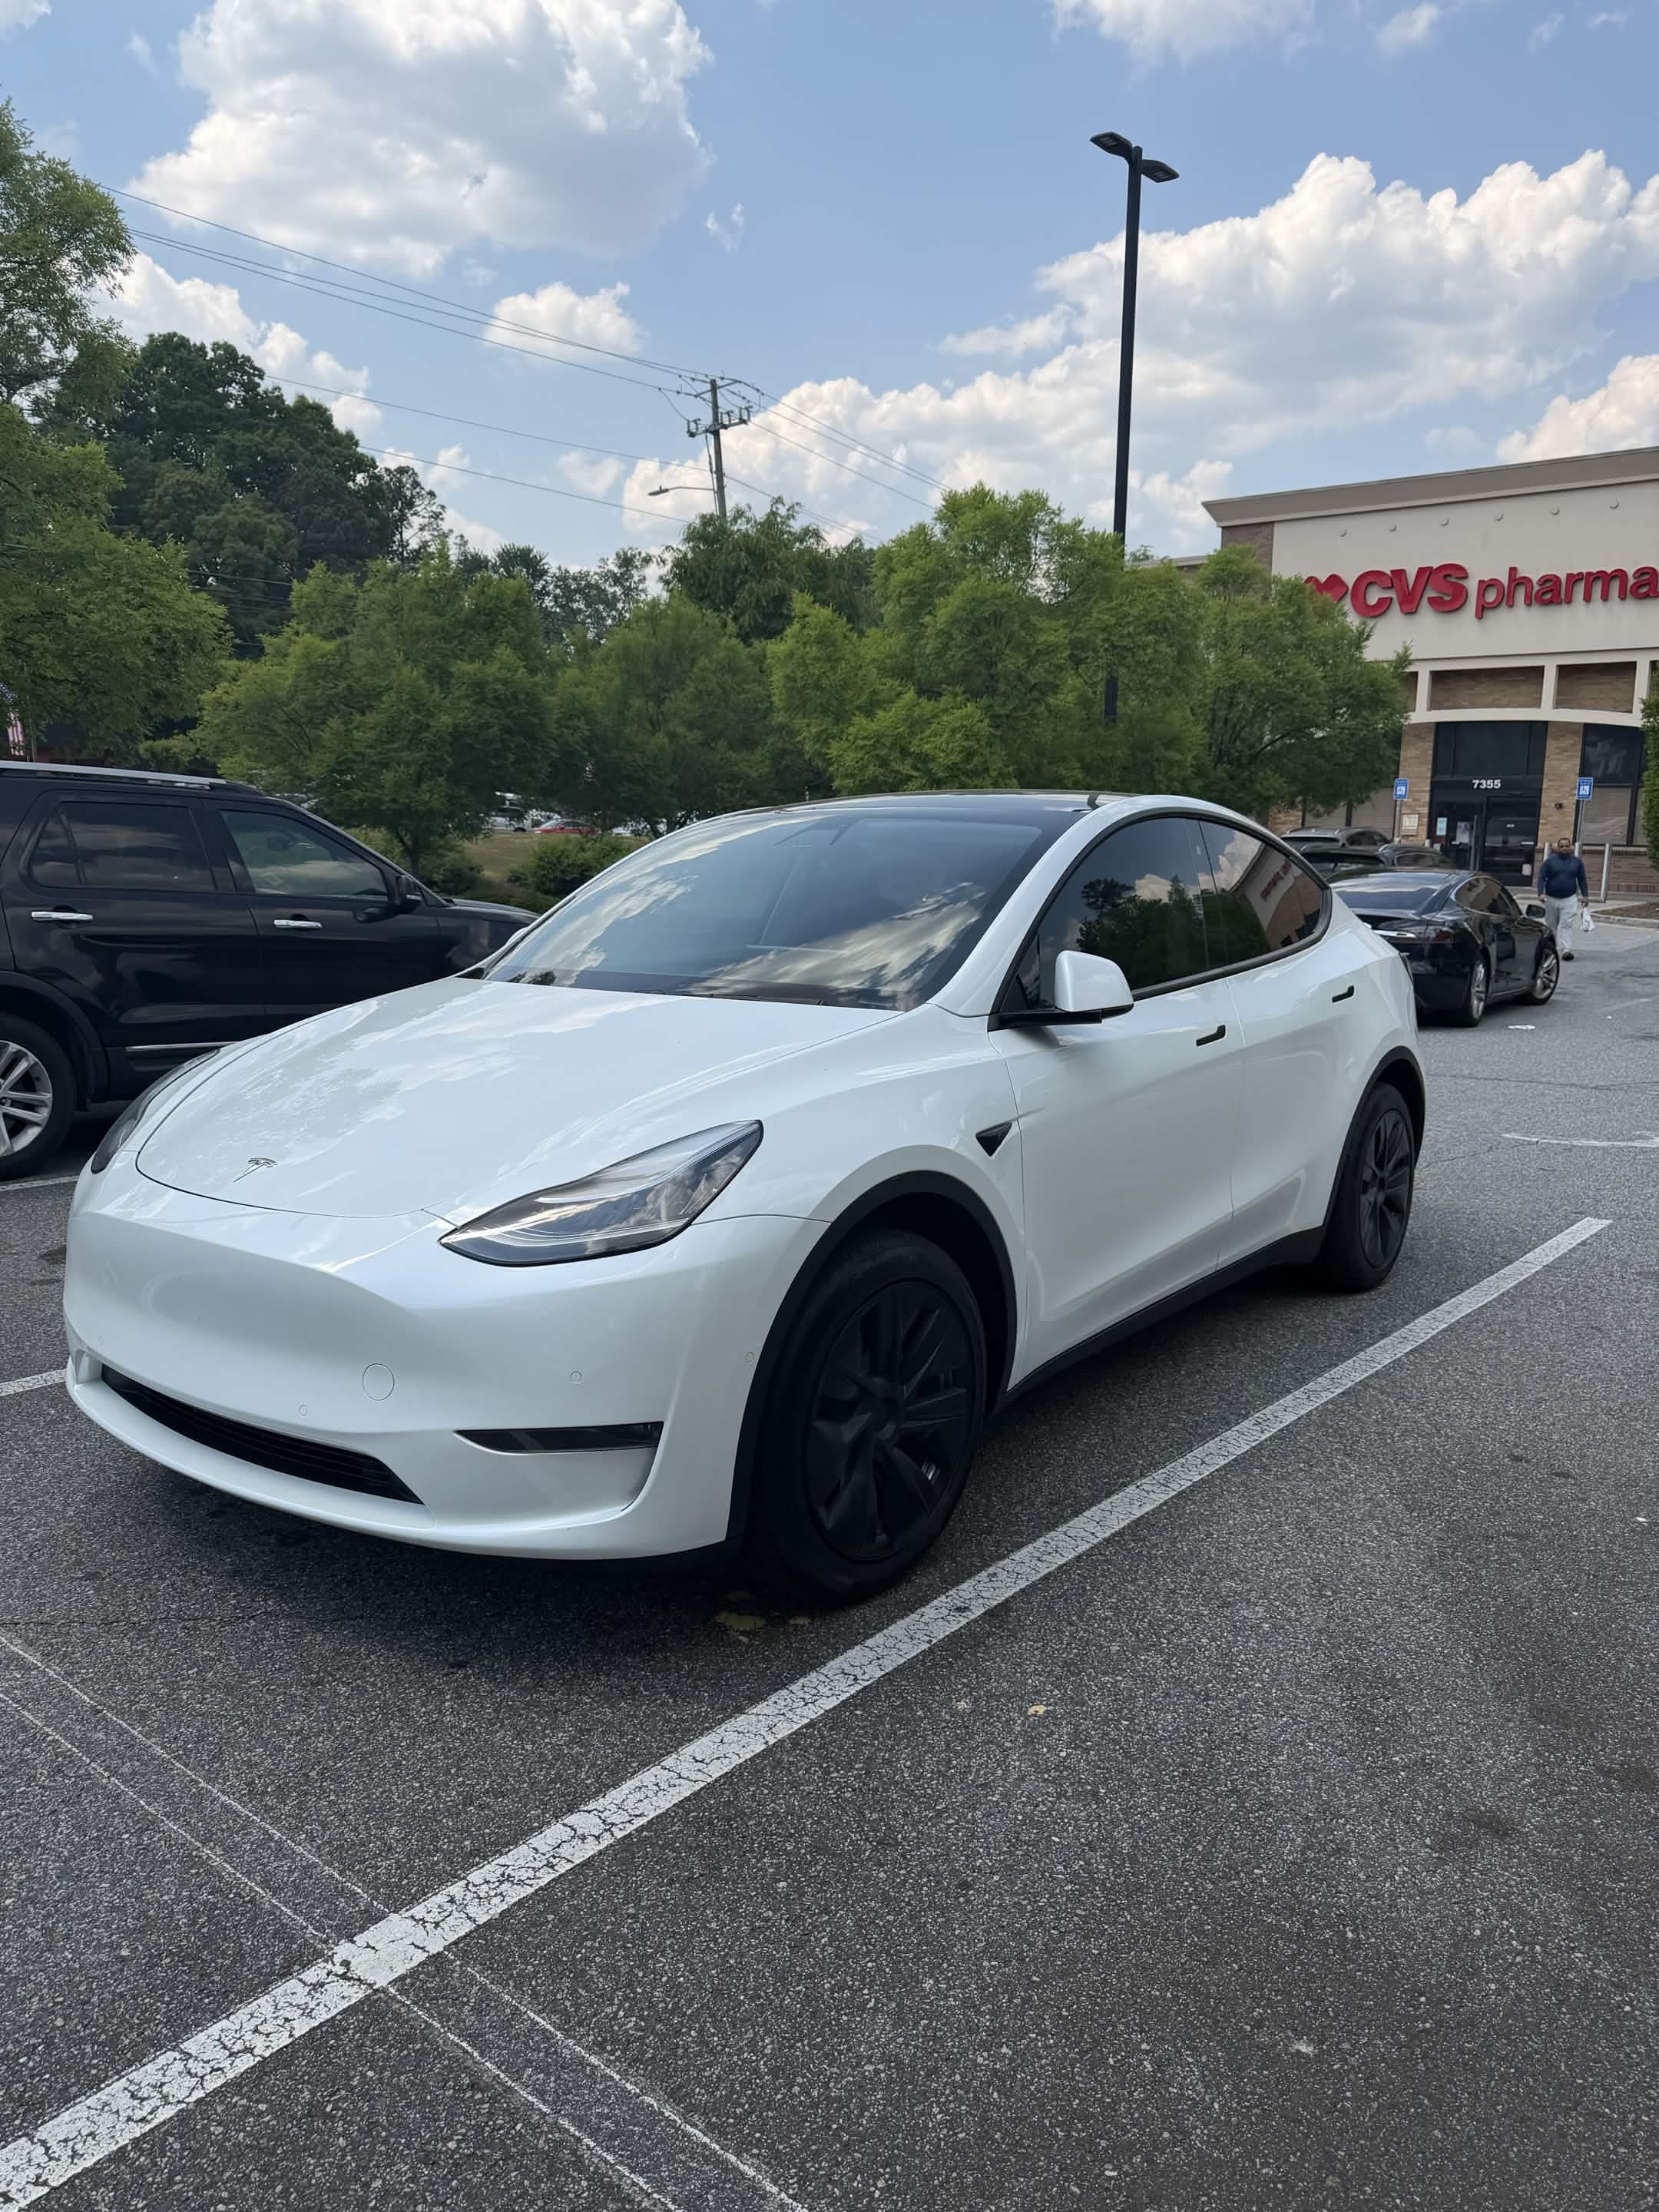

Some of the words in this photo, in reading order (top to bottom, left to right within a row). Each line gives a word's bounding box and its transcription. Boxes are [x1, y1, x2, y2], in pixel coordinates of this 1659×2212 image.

[1350, 563, 1469, 618] CVS
[1475, 566, 1659, 619] pharma
[1472, 780, 1502, 789] 7355
